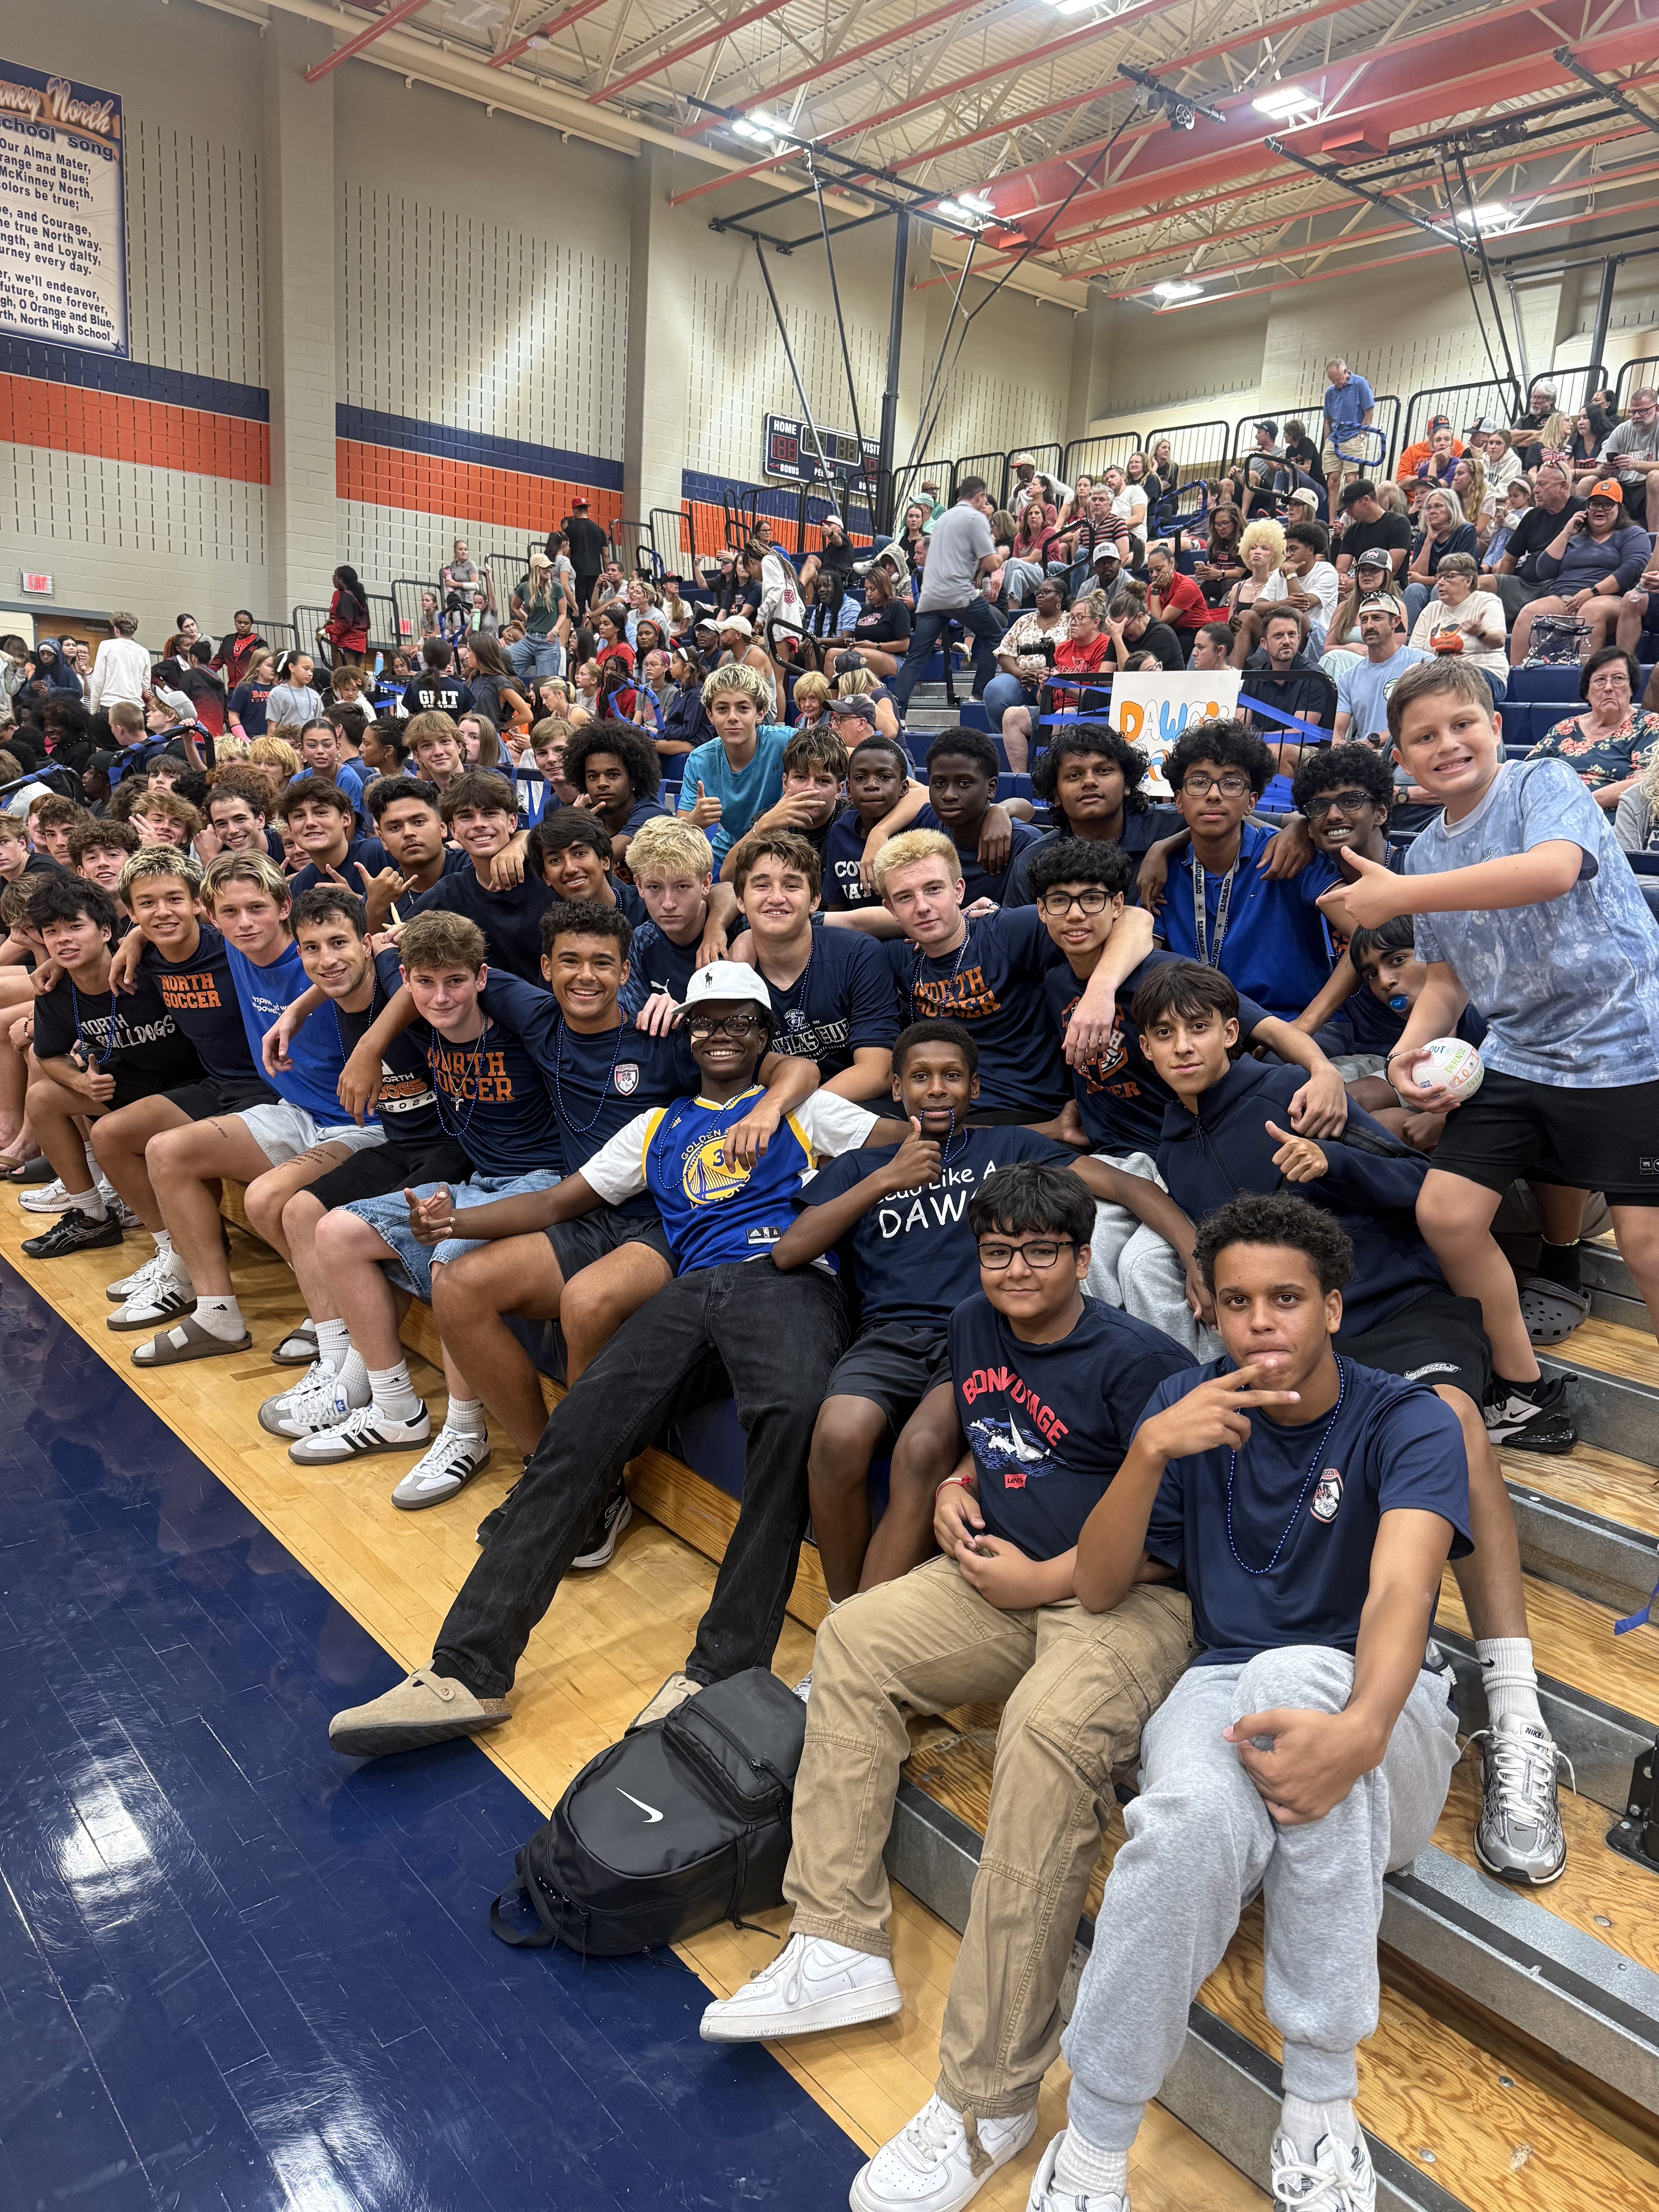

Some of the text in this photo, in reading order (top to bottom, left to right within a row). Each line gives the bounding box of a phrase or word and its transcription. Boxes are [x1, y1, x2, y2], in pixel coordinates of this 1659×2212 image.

[46, 77, 114, 134] North
[0, 117, 114, 162] chool song
[0, 138, 91, 175] Our Alma Mater,
[0, 165, 93, 202] McKinney North,
[36, 163, 56, 176] and
[61, 168, 88, 187] Blue;
[35, 188, 48, 201] be
[53, 193, 79, 211] true;
[15, 220, 38, 235] true
[43, 227, 73, 244] North
[78, 238, 102, 252] way.
[17, 210, 37, 222] and
[42, 214, 91, 237] Courage,
[34, 241, 54, 252] and
[58, 244, 100, 266] Loyalty,
[35, 254, 65, 270] every
[70, 261, 91, 276] day.
[15, 273, 41, 287] we'll
[46, 281, 99, 302] endeavor,
[19, 299, 26, 309] O
[30, 301, 66, 319] Orange
[69, 313, 87, 323] and
[90, 314, 114, 330] Blue,
[43, 293, 62, 304] one
[66, 296, 108, 316] forever,
[20, 313, 49, 328] North
[52, 319, 74, 334] High
[77, 325, 110, 341] School
[774, 420, 797, 435] HOME
[814, 468, 834, 478] PEOD
[859, 481, 877, 493] BOUS
[1220, 879, 1230, 912] COWBOYS
[158, 973, 215, 991] NORTH
[914, 966, 988, 1003] NORTH
[163, 990, 222, 1008] SOCCER
[80, 1014, 129, 1035] NORTH
[96, 1015, 175, 1048] BULLDOGS
[815, 1018, 849, 1044] CUP
[433, 1068, 515, 1102] OCCER
[681, 1129, 721, 1160] GOLDEN
[983, 1160, 996, 1180] A
[879, 1187, 977, 1238] DAW
[962, 1367, 1001, 1405] BON
[1525, 1727, 1542, 1739] NIKE
